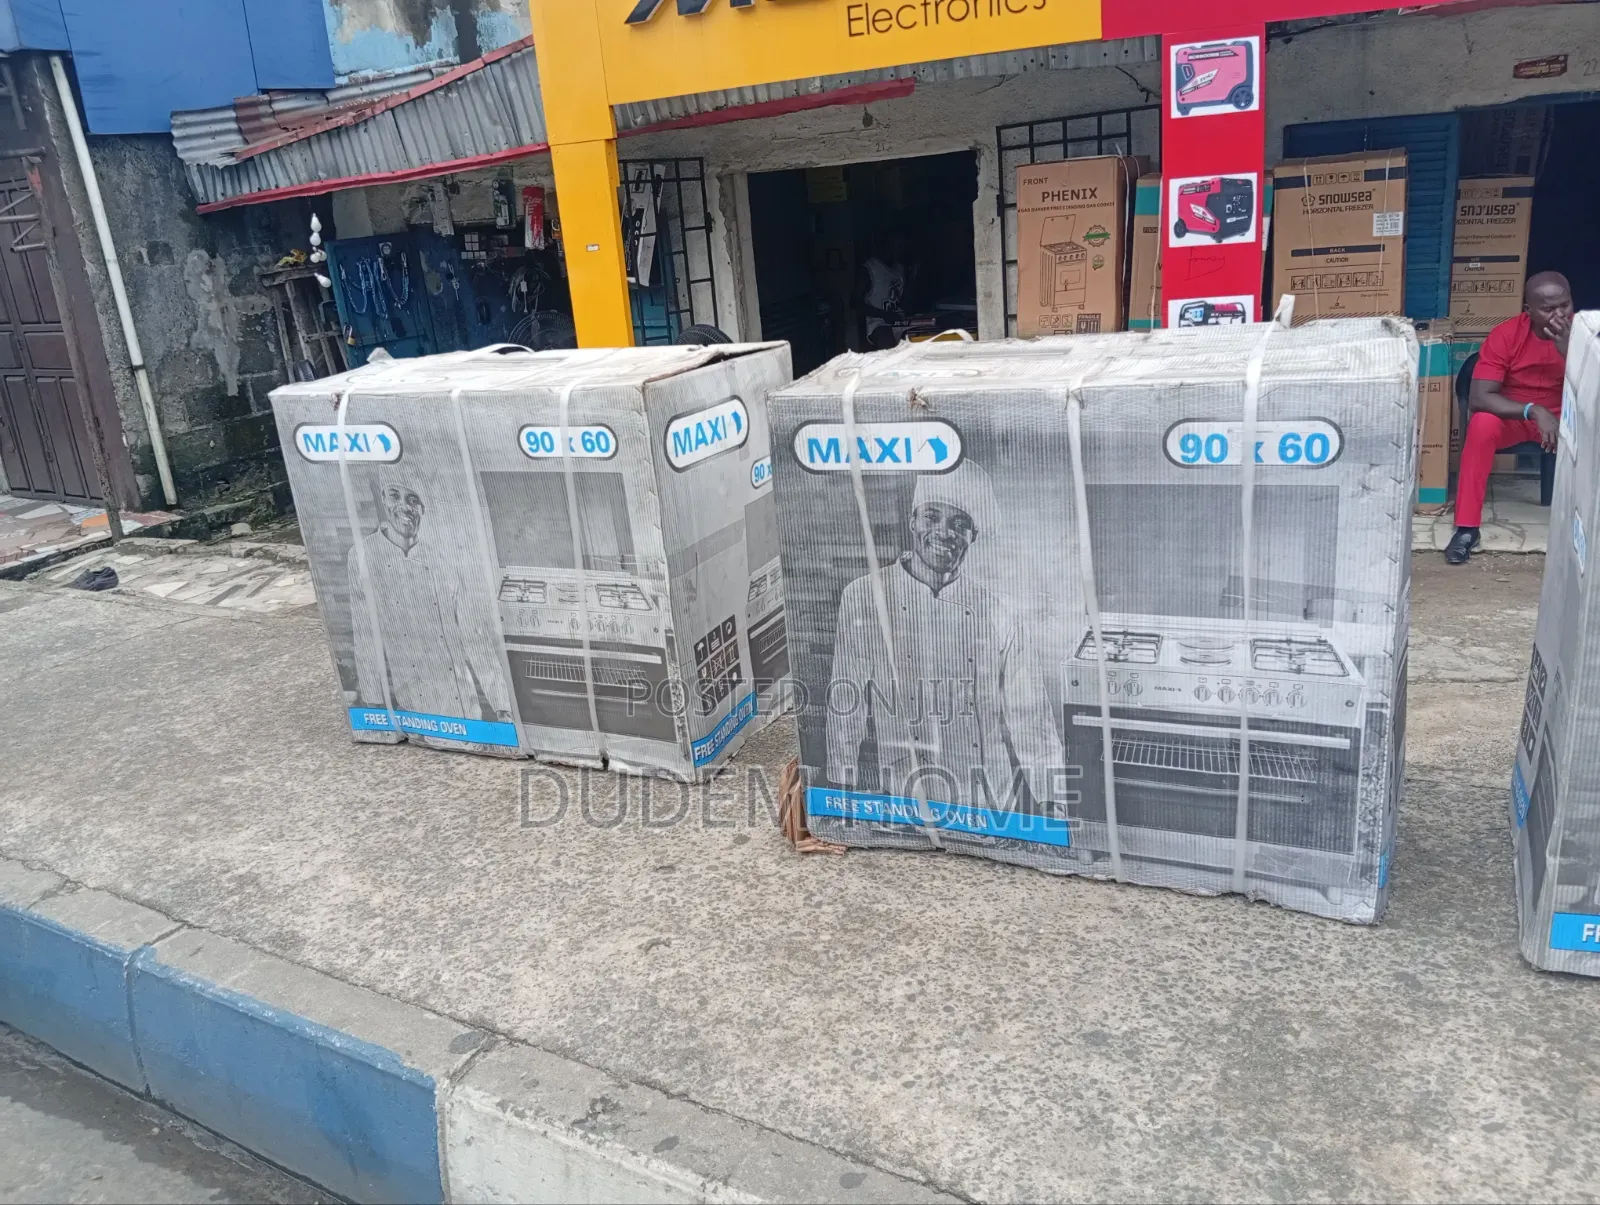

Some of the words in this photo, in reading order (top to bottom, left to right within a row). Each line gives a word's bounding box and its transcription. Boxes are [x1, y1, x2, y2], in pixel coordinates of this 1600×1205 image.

[1023, 177, 1048, 186] FRONT
[1042, 187, 1098, 202] PHENIX
[1319, 190, 1372, 206] snowsea
[1302, 206, 1344, 215] HORIZONTAL
[1345, 203, 1374, 212] FREEZER
[303, 432, 371, 453] MAXI
[525, 431, 554, 453] 90
[581, 430, 610, 453] 60
[671, 415, 728, 458] MAXI
[807, 437, 913, 464] MAXI
[1179, 433, 1228, 464] 90
[1278, 432, 1330, 464] 60
[753, 465, 765, 483] 90
[363, 713, 389, 726] FREE
[396, 715, 438, 732] TANDING
[440, 721, 468, 736] OVEN
[694, 741, 716, 761] FREE
[825, 796, 859, 813] FREE
[863, 799, 941, 820] STANDIG
[949, 808, 988, 829] OVEN
